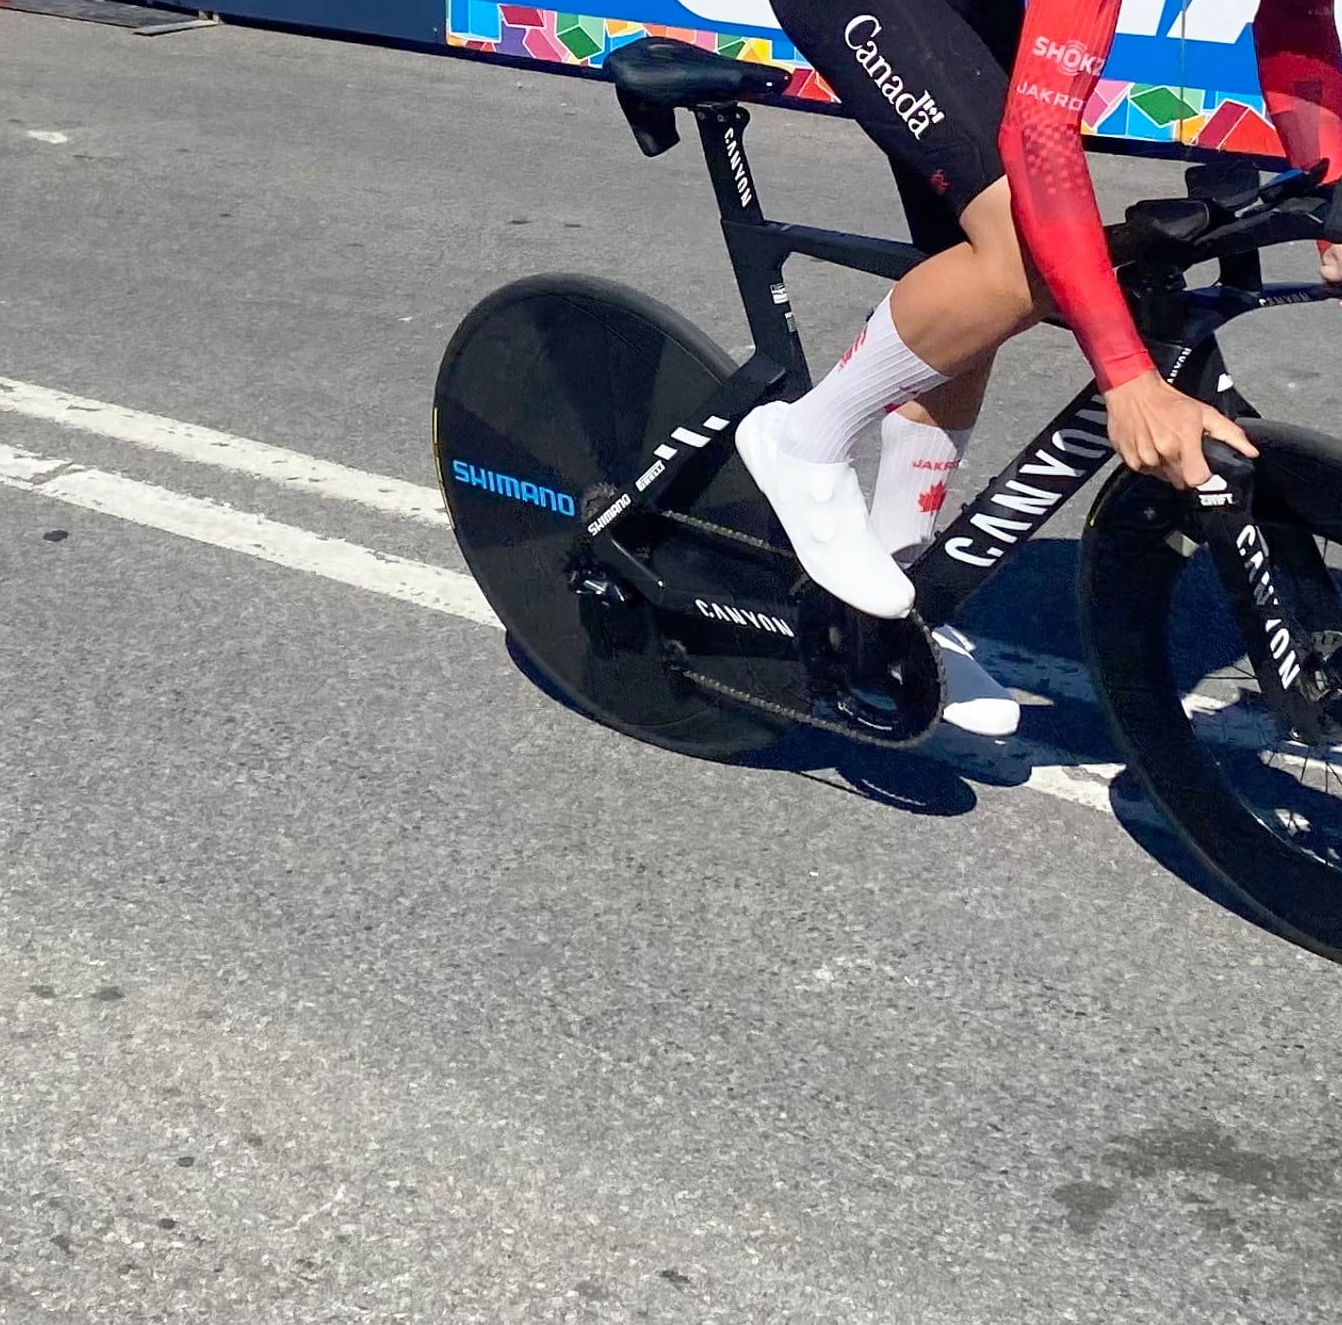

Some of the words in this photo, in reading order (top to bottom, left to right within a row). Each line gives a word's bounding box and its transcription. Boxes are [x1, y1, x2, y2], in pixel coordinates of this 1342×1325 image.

[844, 14, 932, 140] Canada
[720, 127, 752, 207] CANYON
[453, 459, 575, 517] SHIMANO
[587, 492, 631, 536] SHIMANO
[694, 599, 795, 637] CANYON
